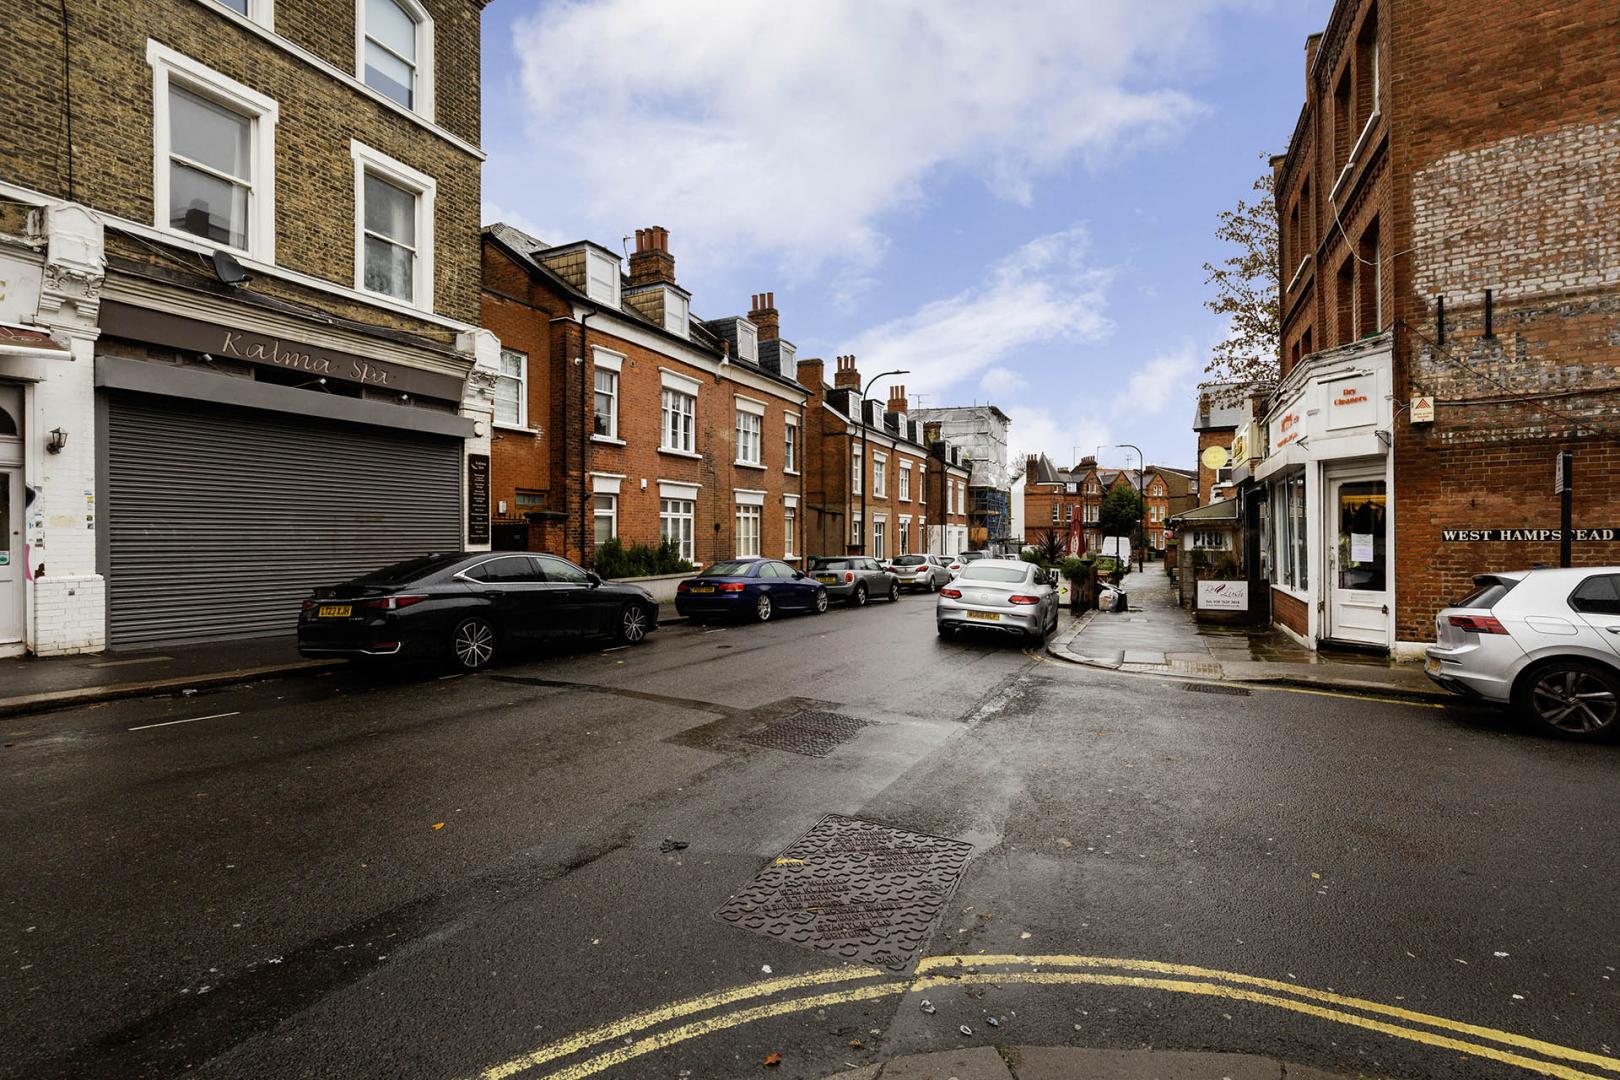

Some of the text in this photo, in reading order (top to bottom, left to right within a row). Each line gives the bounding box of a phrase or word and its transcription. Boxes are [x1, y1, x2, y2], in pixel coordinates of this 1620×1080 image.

[222, 331, 391, 385] Kalma Spa
[1443, 529, 1492, 541] WEST
